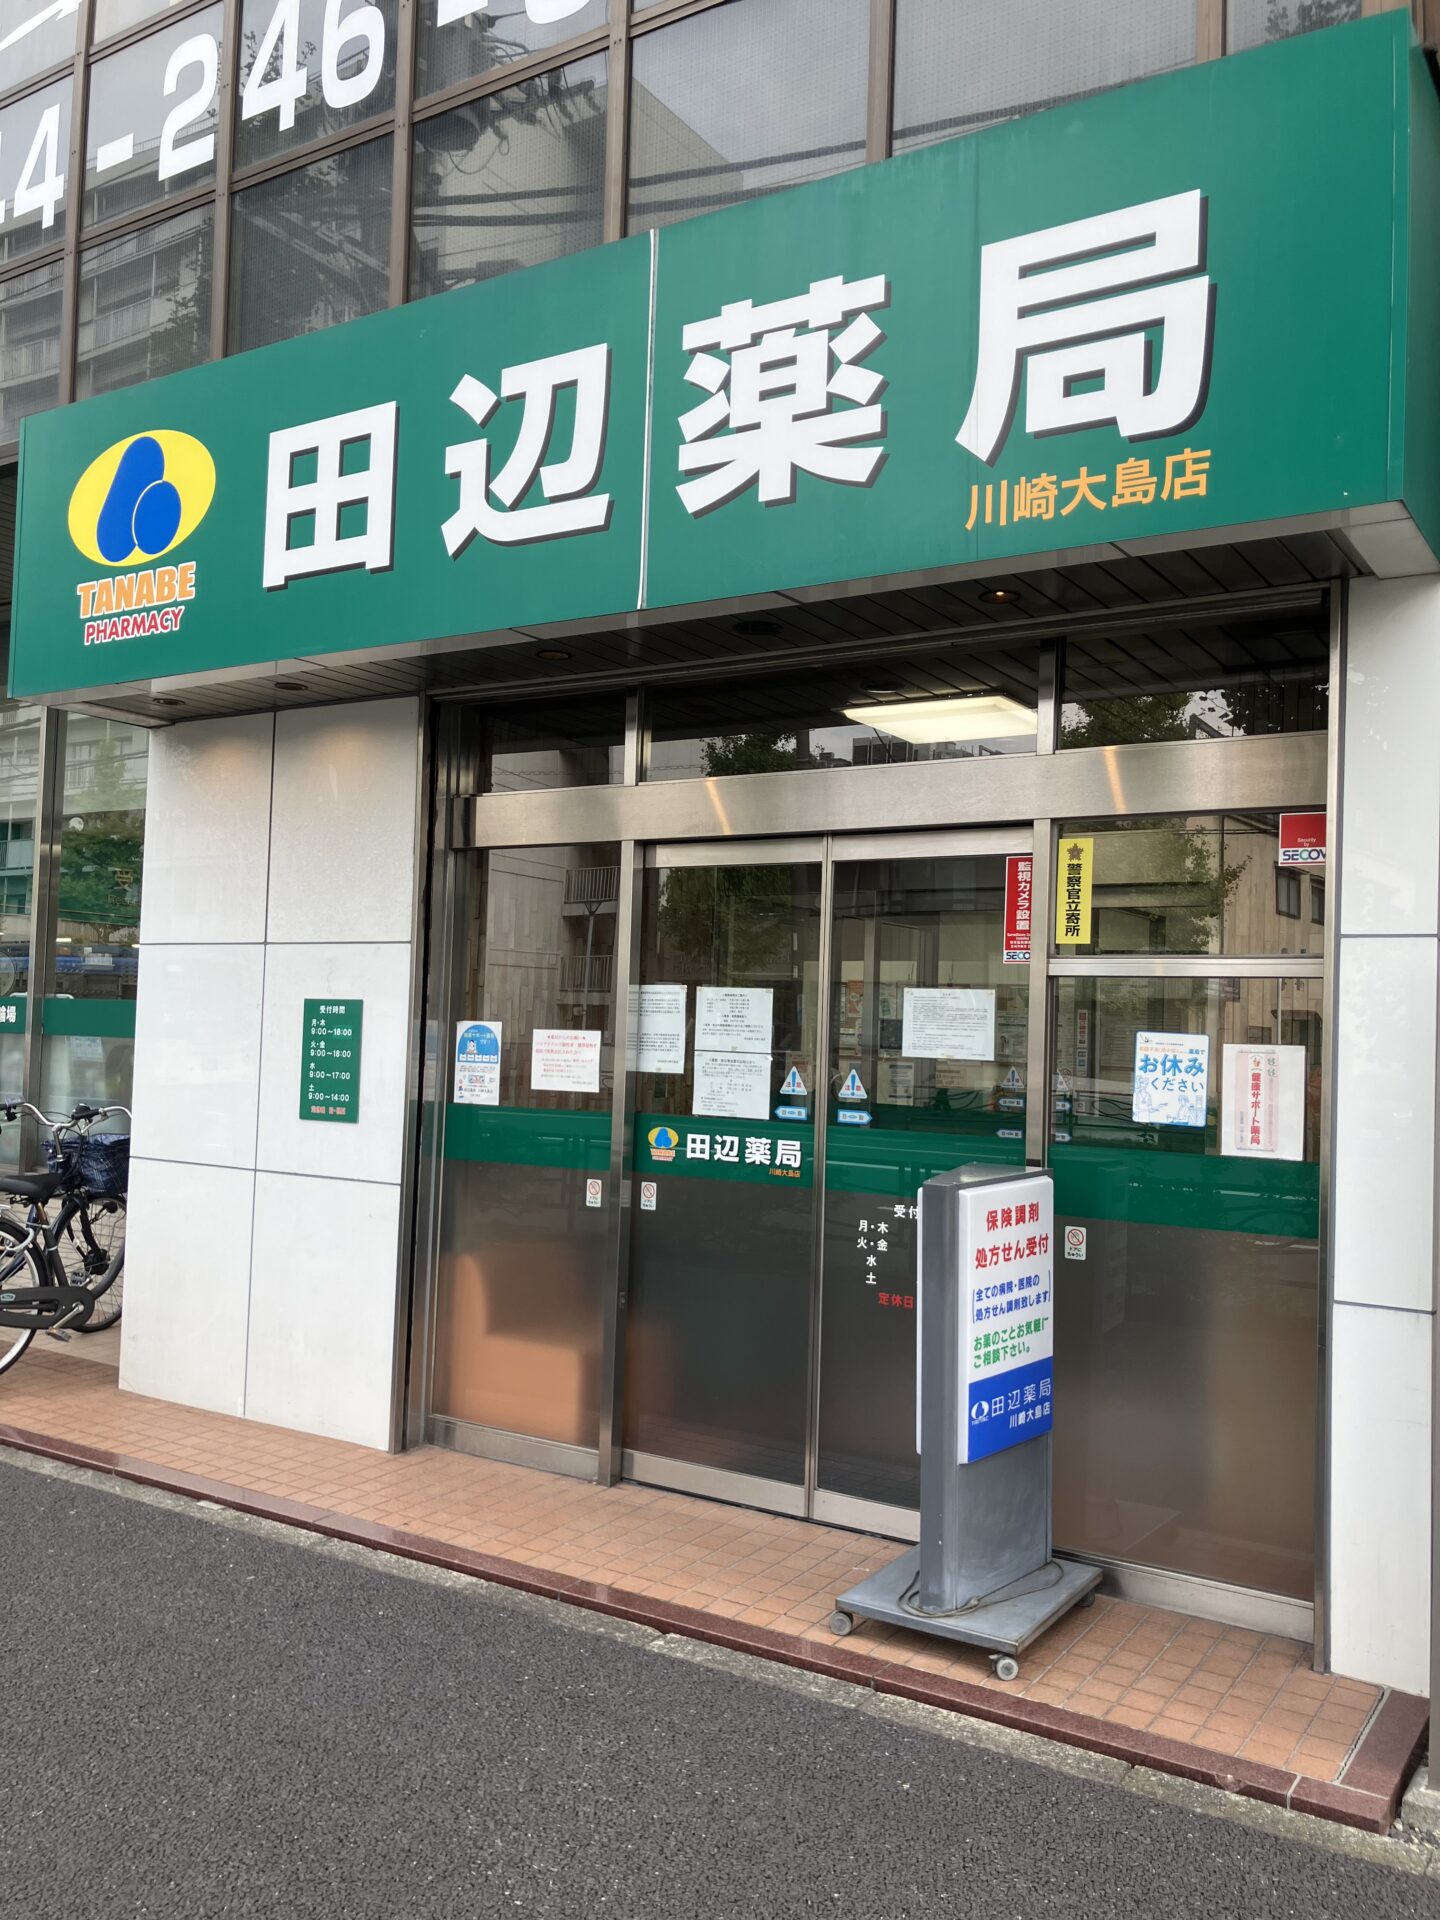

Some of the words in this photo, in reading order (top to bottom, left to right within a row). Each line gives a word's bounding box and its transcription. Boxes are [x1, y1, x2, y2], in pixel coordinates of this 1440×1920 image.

[264, 189, 1209, 587] 田辺薬局
[966, 448, 1212, 532] 川崎大島店
[77, 561, 197, 619] TANABE
[85, 606, 185, 645] PHARMACY
[1016, 862, 1032, 931] 監視カメラ設置
[1065, 863, 1082, 937] 警察官立寄所
[311, 1019, 326, 1027] 月・木
[319, 1005, 346, 1015] 受付時間
[310, 1040, 326, 1049] 火・金
[1138, 1053, 1205, 1077] お休み
[308, 1083, 315, 1092] 土
[1151, 1077, 1204, 1093] ください
[686, 1133, 802, 1168] 田辺薬局
[893, 1204, 918, 1219] 受付
[986, 1201, 1040, 1232] 保険調剤
[858, 1219, 889, 1234] 月・木
[856, 1236, 888, 1252] 火・金
[975, 1233, 1049, 1269] 処方せん受付
[866, 1254, 877, 1267] 水
[865, 1272, 877, 1285] 土
[975, 1274, 1040, 1302] 全ての病院・医院の
[878, 1292, 914, 1309] 定休日
[975, 1290, 1049, 1321] 処方せん調剤致します
[973, 1341, 1031, 1369] ご相談下さい。
[991, 1378, 1051, 1418] 田辺薬局
[1009, 1401, 1051, 1429] 川崎大島店
